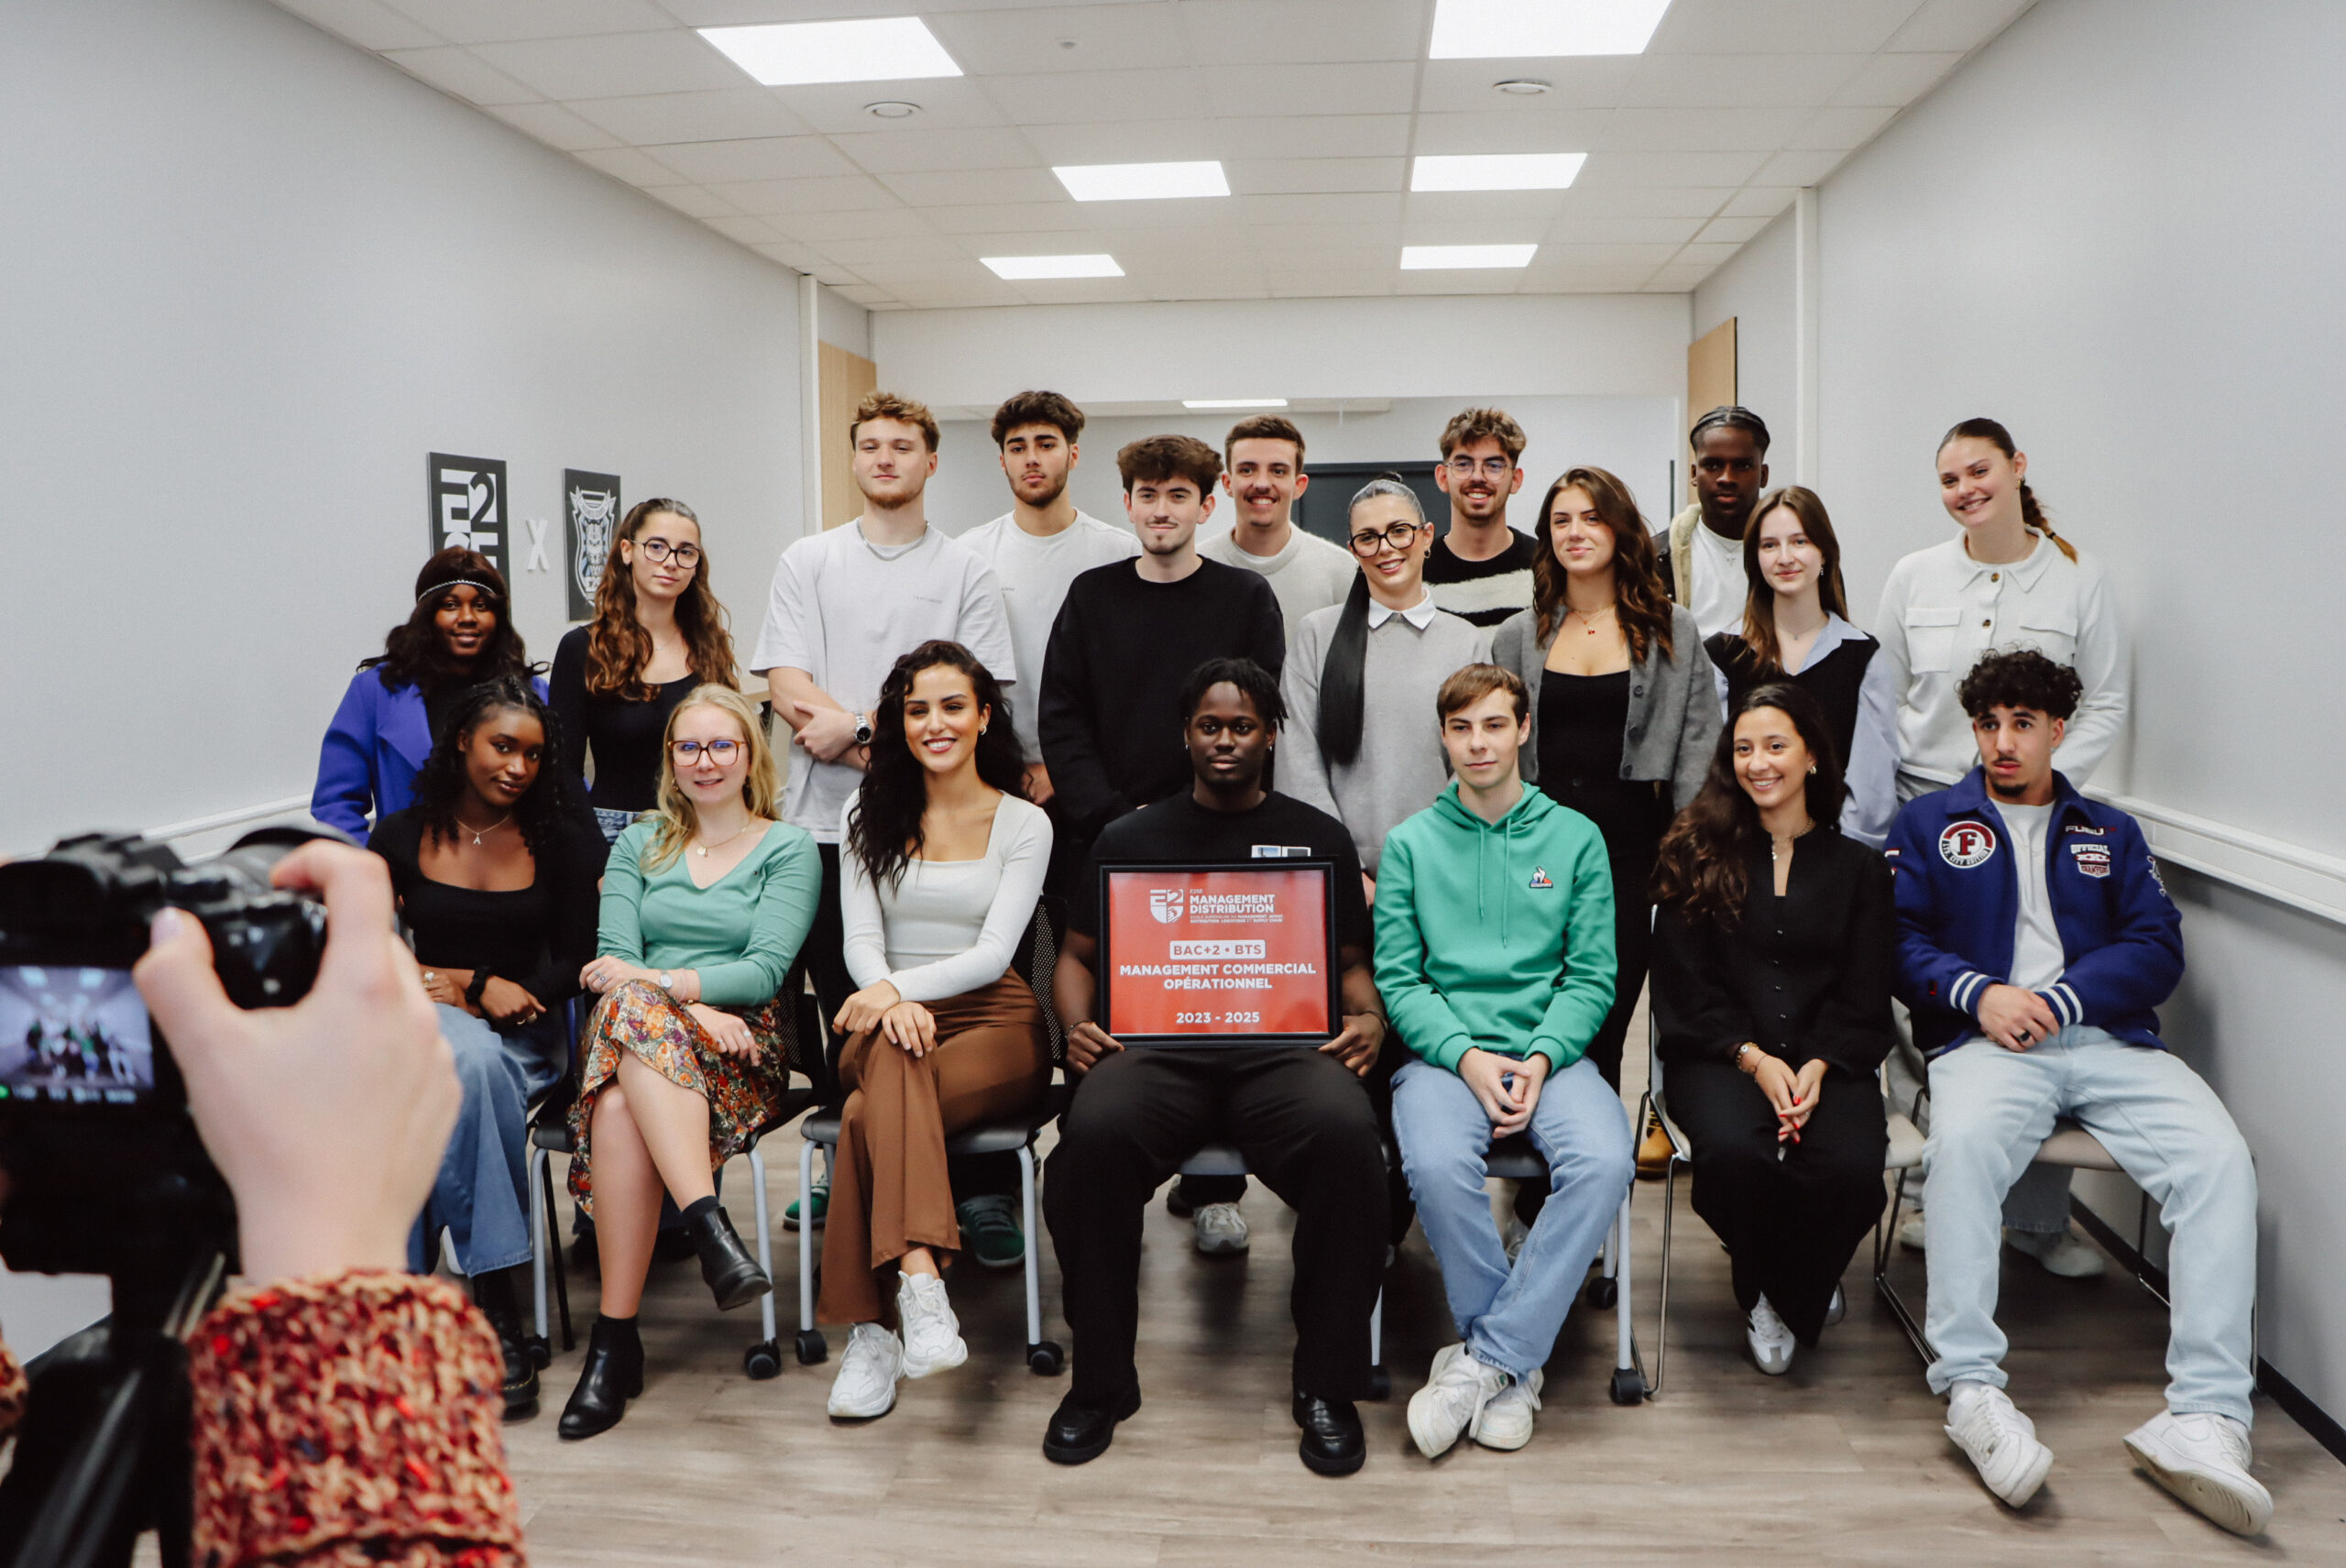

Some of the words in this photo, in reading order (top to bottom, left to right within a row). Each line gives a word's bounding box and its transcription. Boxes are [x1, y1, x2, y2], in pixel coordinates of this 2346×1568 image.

[1957, 831, 1978, 856] F
[2070, 844, 2110, 856] OFFICIAL
[1189, 894, 1276, 905] MANAGEMENT
[1189, 904, 1275, 914] DISTRIBUTION
[1173, 945, 1221, 956] BAC+2
[1234, 945, 1262, 955] BTS
[1120, 964, 1219, 976] MANAGEMENT
[1222, 963, 1316, 975] COMMERCIAL
[1163, 976, 1273, 990] OPÉRATIONNEL
[1176, 1012, 1211, 1024] 2023
[1224, 1012, 1260, 1023] 2025
